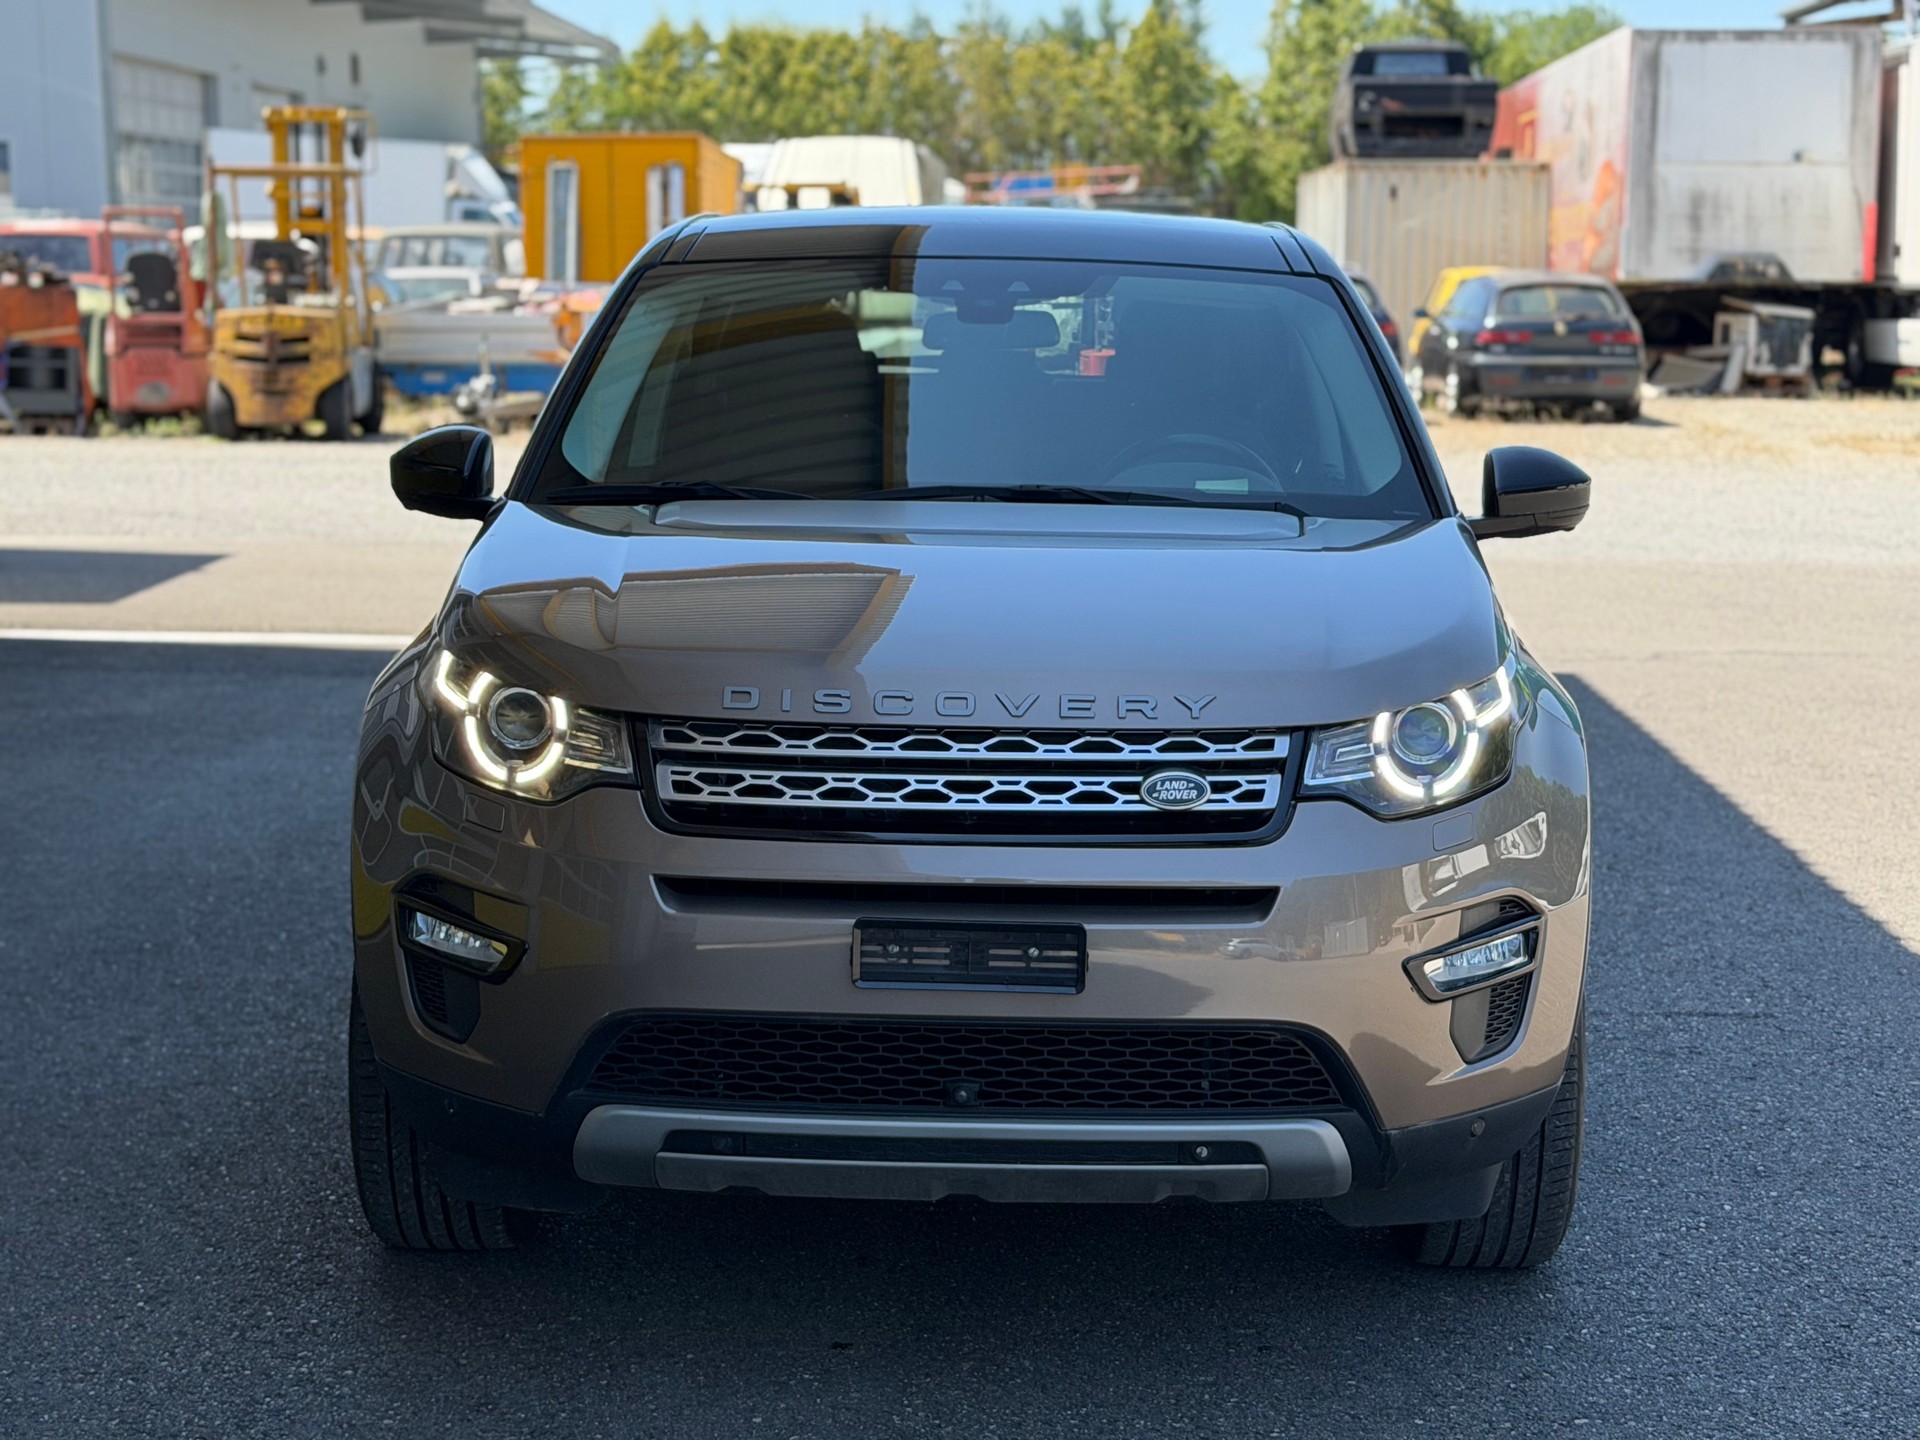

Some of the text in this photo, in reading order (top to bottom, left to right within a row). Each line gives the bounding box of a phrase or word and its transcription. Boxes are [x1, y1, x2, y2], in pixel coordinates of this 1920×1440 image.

[721, 685, 1217, 720] DISCOVERY
[1156, 780, 1187, 790] LAND
[1159, 789, 1197, 800] ROVER
